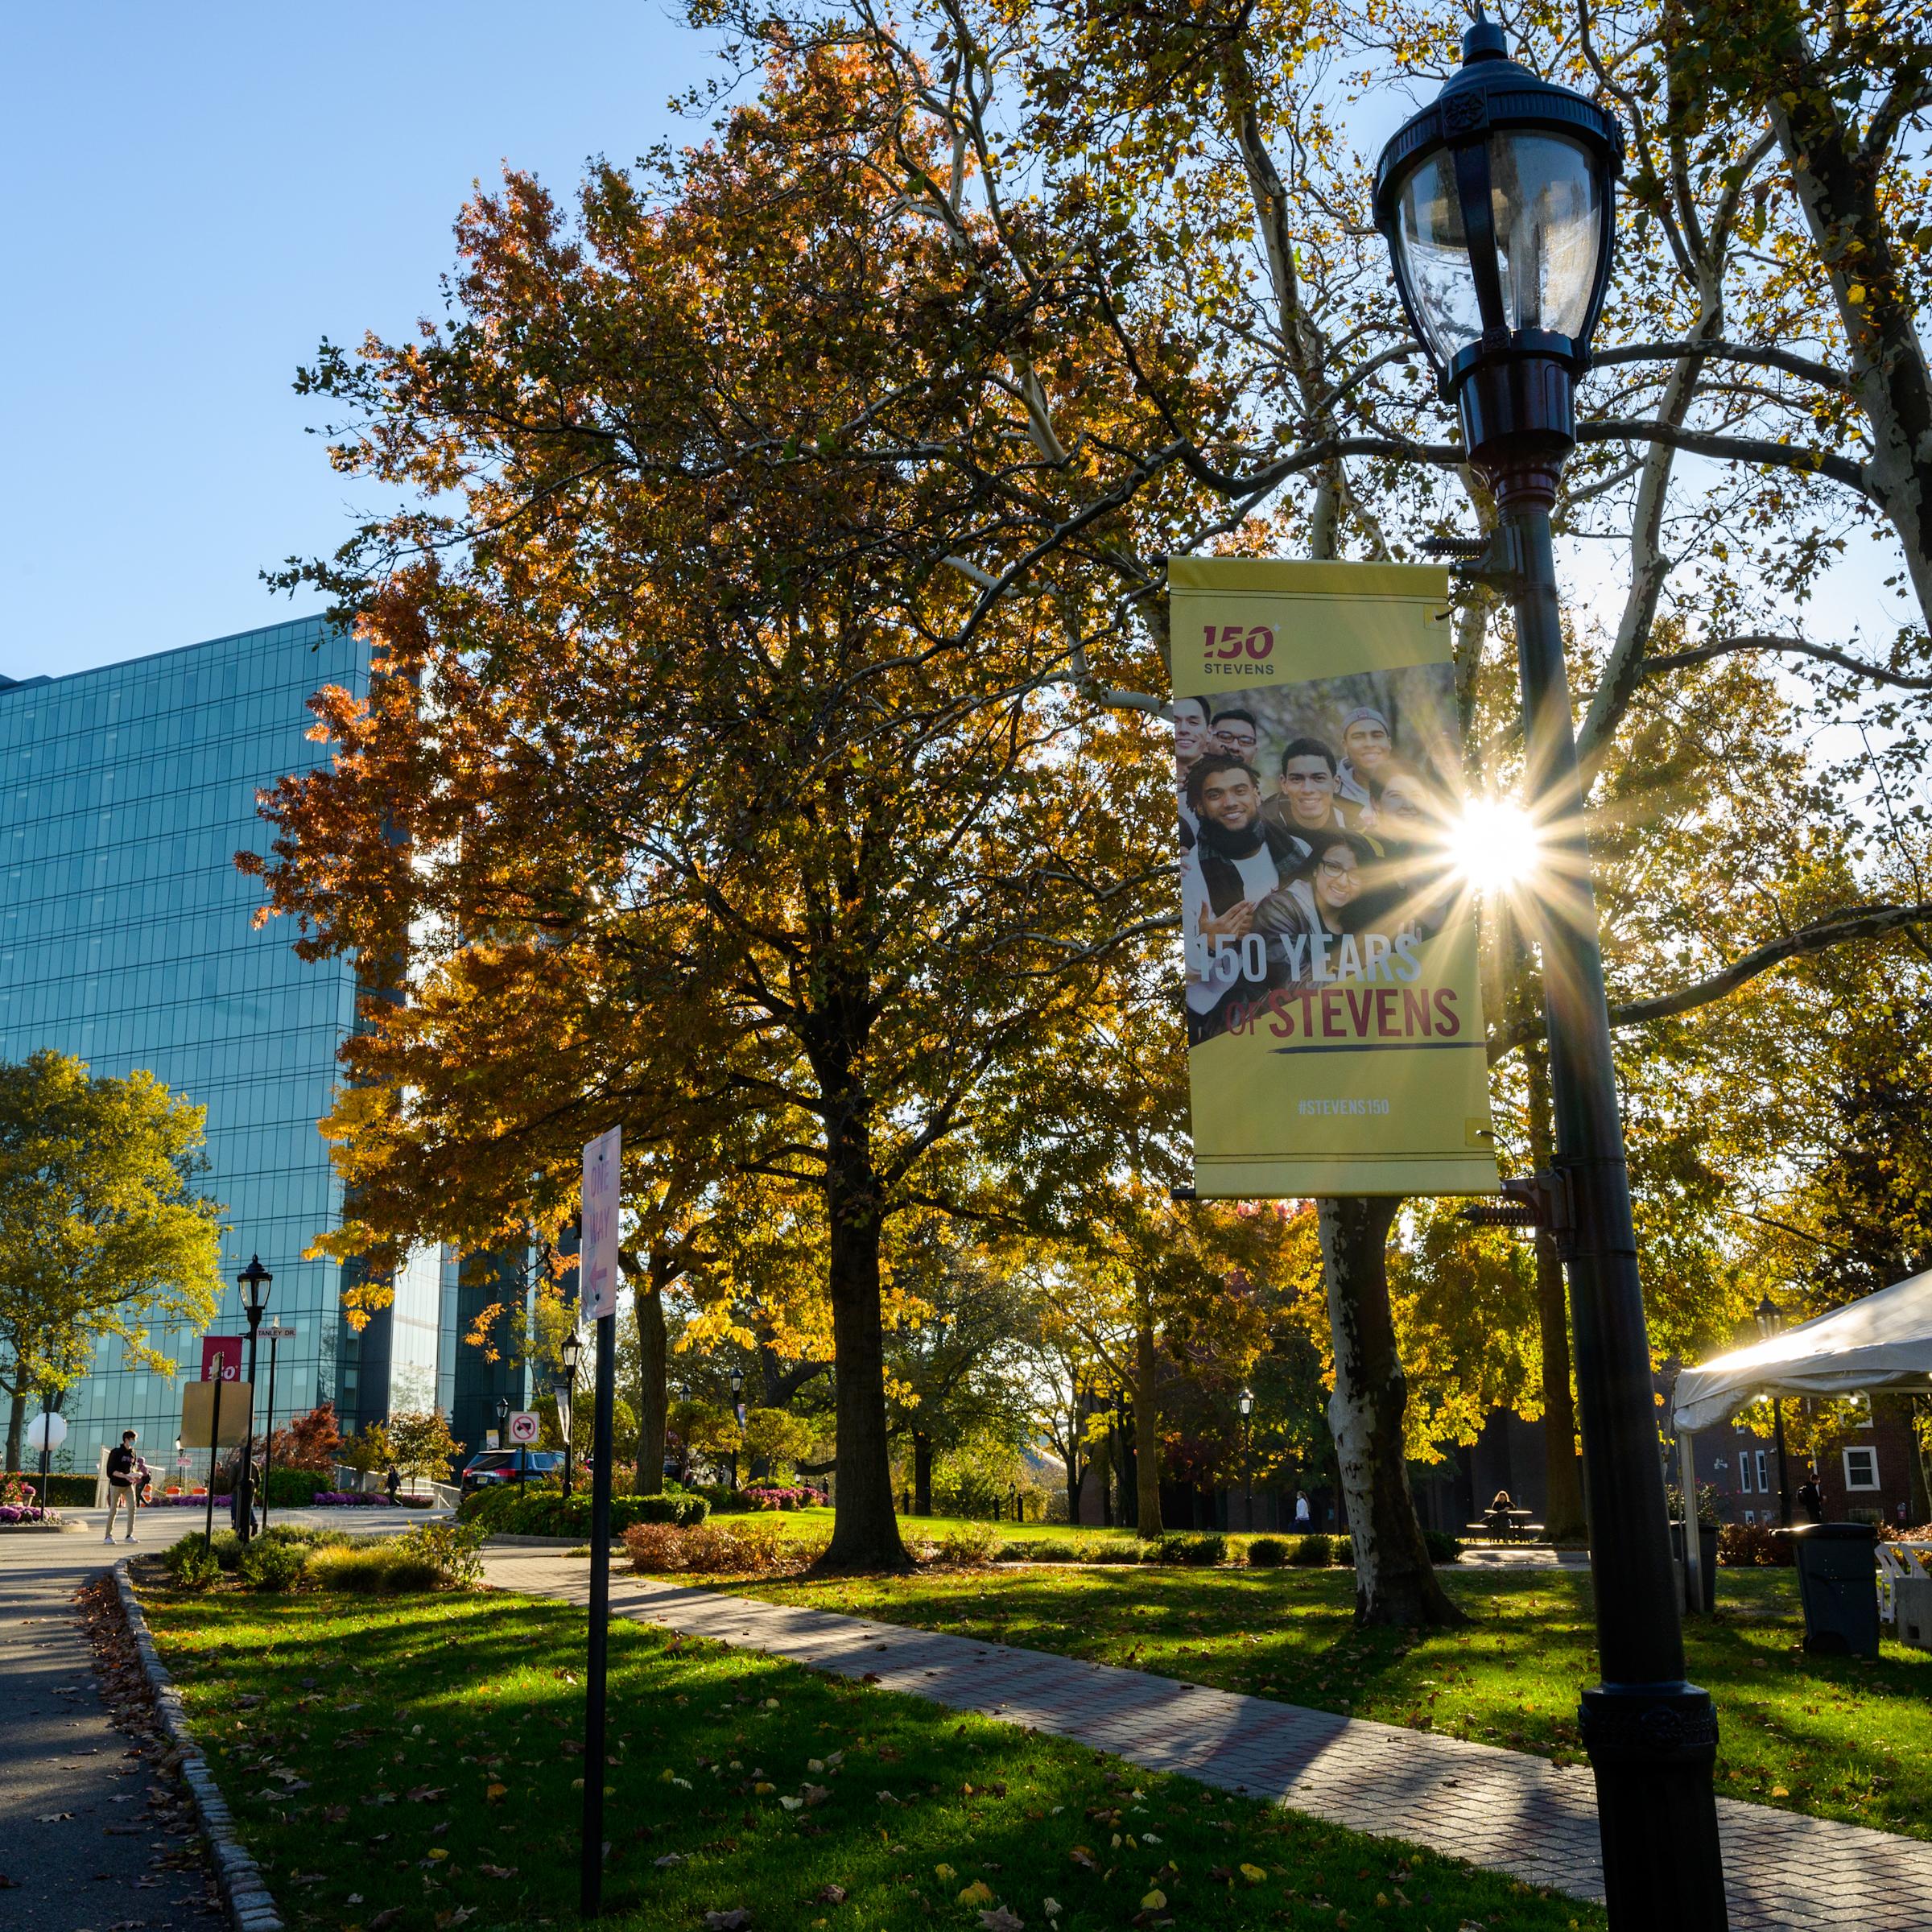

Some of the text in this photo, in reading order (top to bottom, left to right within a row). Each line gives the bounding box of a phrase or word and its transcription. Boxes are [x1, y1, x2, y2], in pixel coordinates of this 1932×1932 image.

[1203, 625, 1274, 660] 150
[1204, 663, 1274, 675] STEVENS
[1197, 933, 1422, 983] 150 YEARS
[1225, 988, 1460, 1038] OF STEVENS
[1298, 1099, 1390, 1116] #STEVENS150
[591, 1159, 609, 1198] ONE
[590, 1206, 611, 1245] WAY
